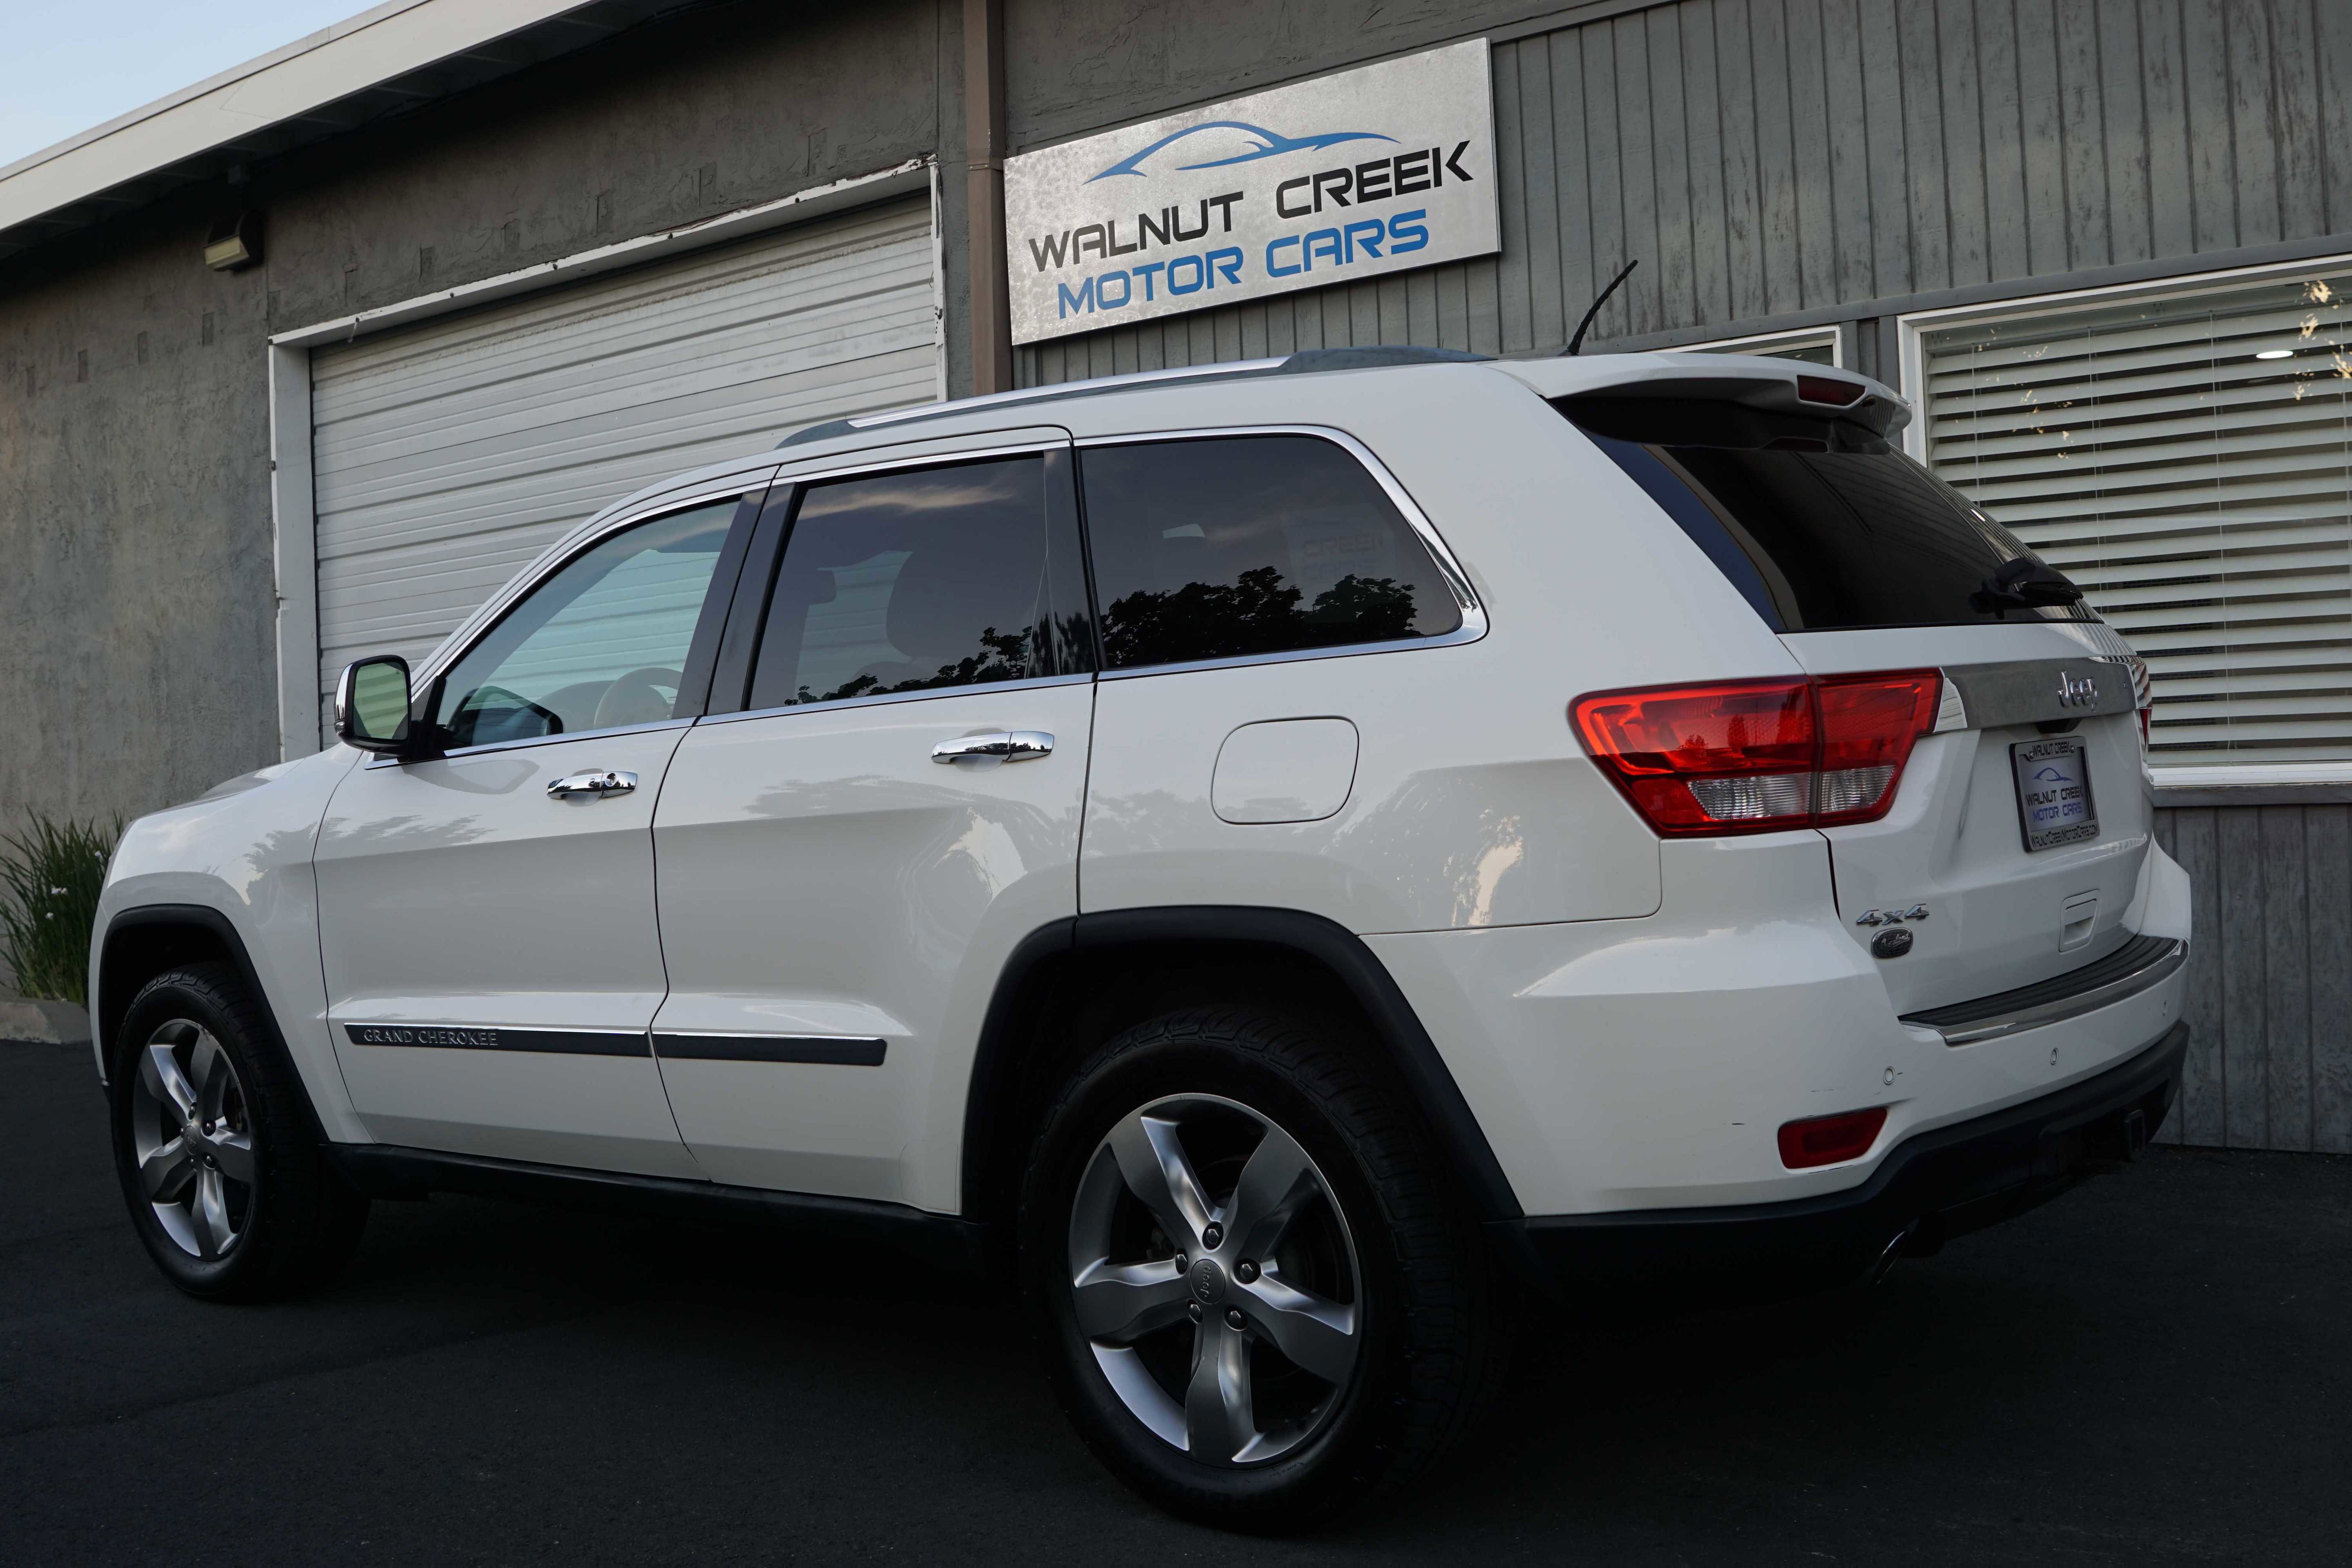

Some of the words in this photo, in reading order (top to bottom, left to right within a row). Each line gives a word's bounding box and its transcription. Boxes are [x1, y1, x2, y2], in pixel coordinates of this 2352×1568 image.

[1028, 191, 1243, 272] WALNUT
[1276, 140, 1473, 219] CREEK
[1059, 246, 1243, 319] MOTOR
[1266, 209, 1429, 278] CARS
[2057, 670, 2098, 712] Jeep
[2032, 743, 2053, 757] WALNUT
[2054, 741, 2070, 754] CREEK
[2025, 790, 2056, 806] WALNUT
[2060, 786, 2082, 800] CREEK
[2032, 806, 2059, 822] MOTOR
[2062, 802, 2082, 816] CARS
[364, 1029, 413, 1042] GRAND
[418, 1030, 498, 1045] CHEROKEE
